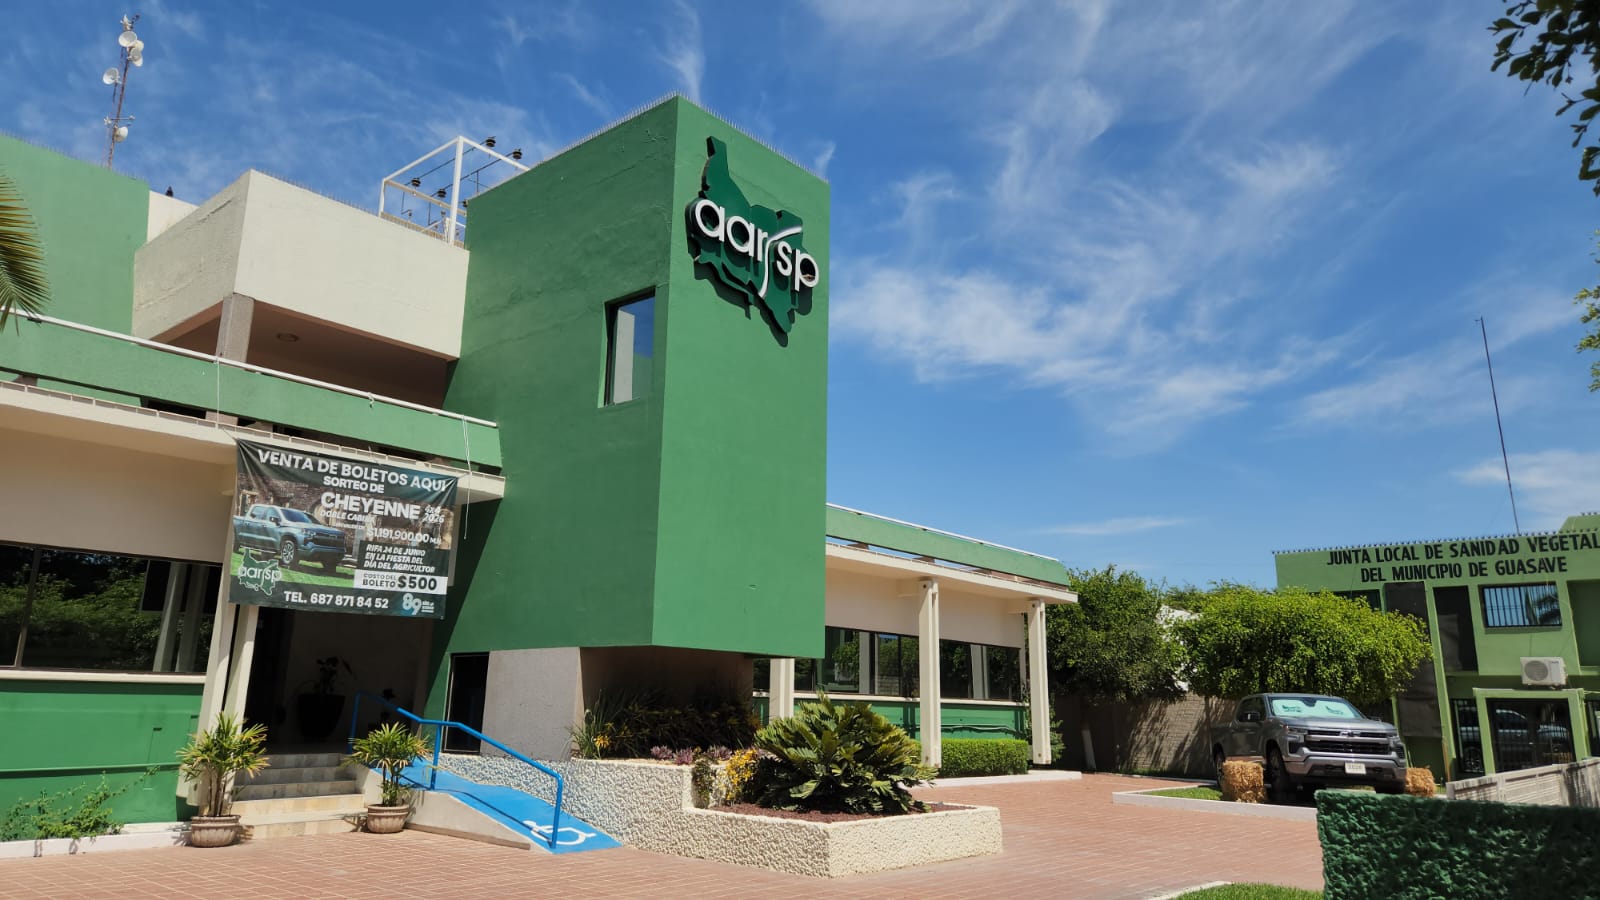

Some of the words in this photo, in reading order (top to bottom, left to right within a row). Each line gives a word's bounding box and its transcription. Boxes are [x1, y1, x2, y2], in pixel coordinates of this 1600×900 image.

[257, 449, 314, 471] VENTA
[317, 460, 338, 475] DE
[341, 464, 408, 485] BOLETOS
[323, 475, 368, 491] SORTEO
[369, 483, 385, 494] DE
[321, 492, 420, 519] CHEYENNE
[320, 510, 347, 520] DOBLE
[366, 544, 383, 553] RIFA
[383, 546, 392, 554] 24
[393, 547, 403, 555] DE
[403, 548, 426, 557] JUNIO
[1327, 548, 1371, 566] JUNTA
[1374, 545, 1419, 563] LOCAL
[1423, 544, 1443, 560] DE
[1449, 538, 1520, 558] SANIDAD
[1526, 532, 1600, 553] VEGETAL
[365, 552, 376, 560] EN
[376, 553, 386, 562] LA
[386, 554, 411, 563] FIESTA
[411, 556, 424, 565] DEL
[378, 562, 392, 570] DEL
[392, 563, 435, 573] AGRICULTOR
[1360, 567, 1387, 583] DEL
[1391, 562, 1462, 581] MUNICIPIO
[1468, 561, 1488, 577] DE
[1494, 556, 1568, 576] GUASAVE
[362, 580, 396, 588] BOLETO
[397, 575, 437, 591] $500
[284, 591, 307, 604] TEL.
[310, 593, 333, 605] 687
[335, 595, 355, 607] 871
[356, 596, 372, 608] 84
[374, 598, 389, 609] 52
[402, 592, 422, 616] 89
